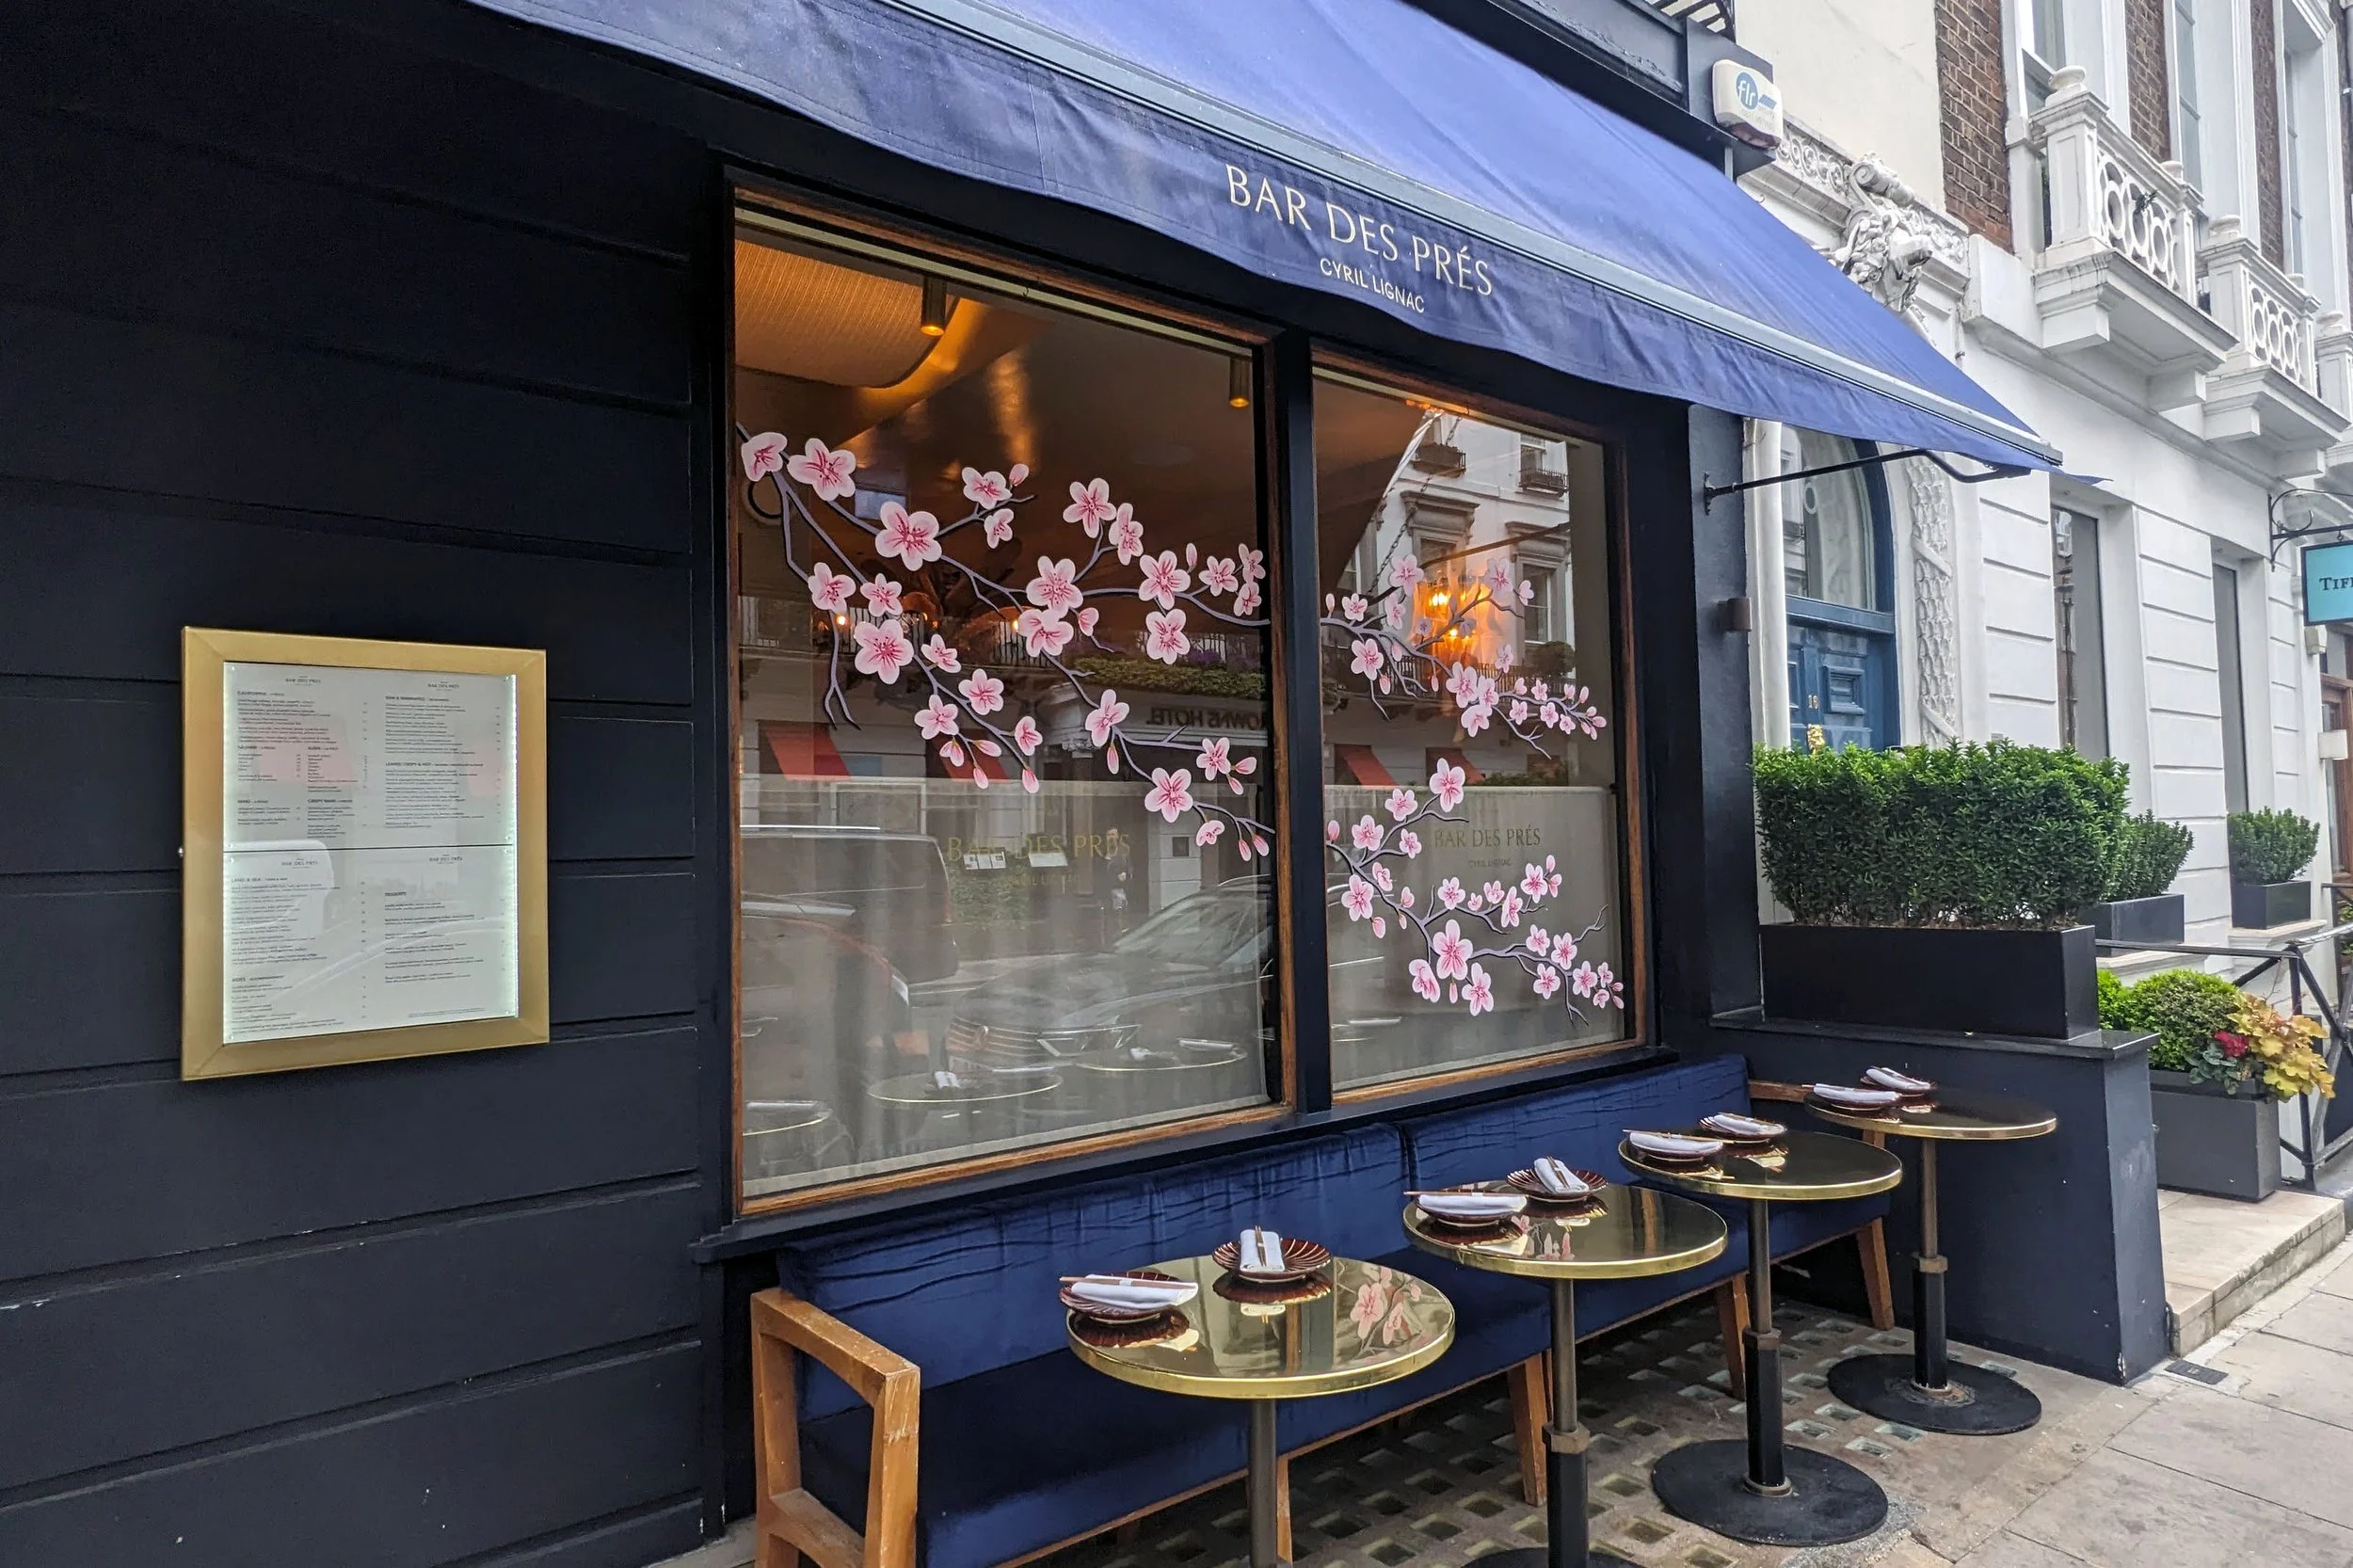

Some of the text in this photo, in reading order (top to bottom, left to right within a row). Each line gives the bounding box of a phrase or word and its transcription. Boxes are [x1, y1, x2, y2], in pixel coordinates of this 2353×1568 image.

[1225, 164, 1492, 296] BAR DES PRÉS
[1320, 258, 1424, 313] CYRIL LIGNAC
[1434, 824, 1542, 847] BAR DES PRÉS
